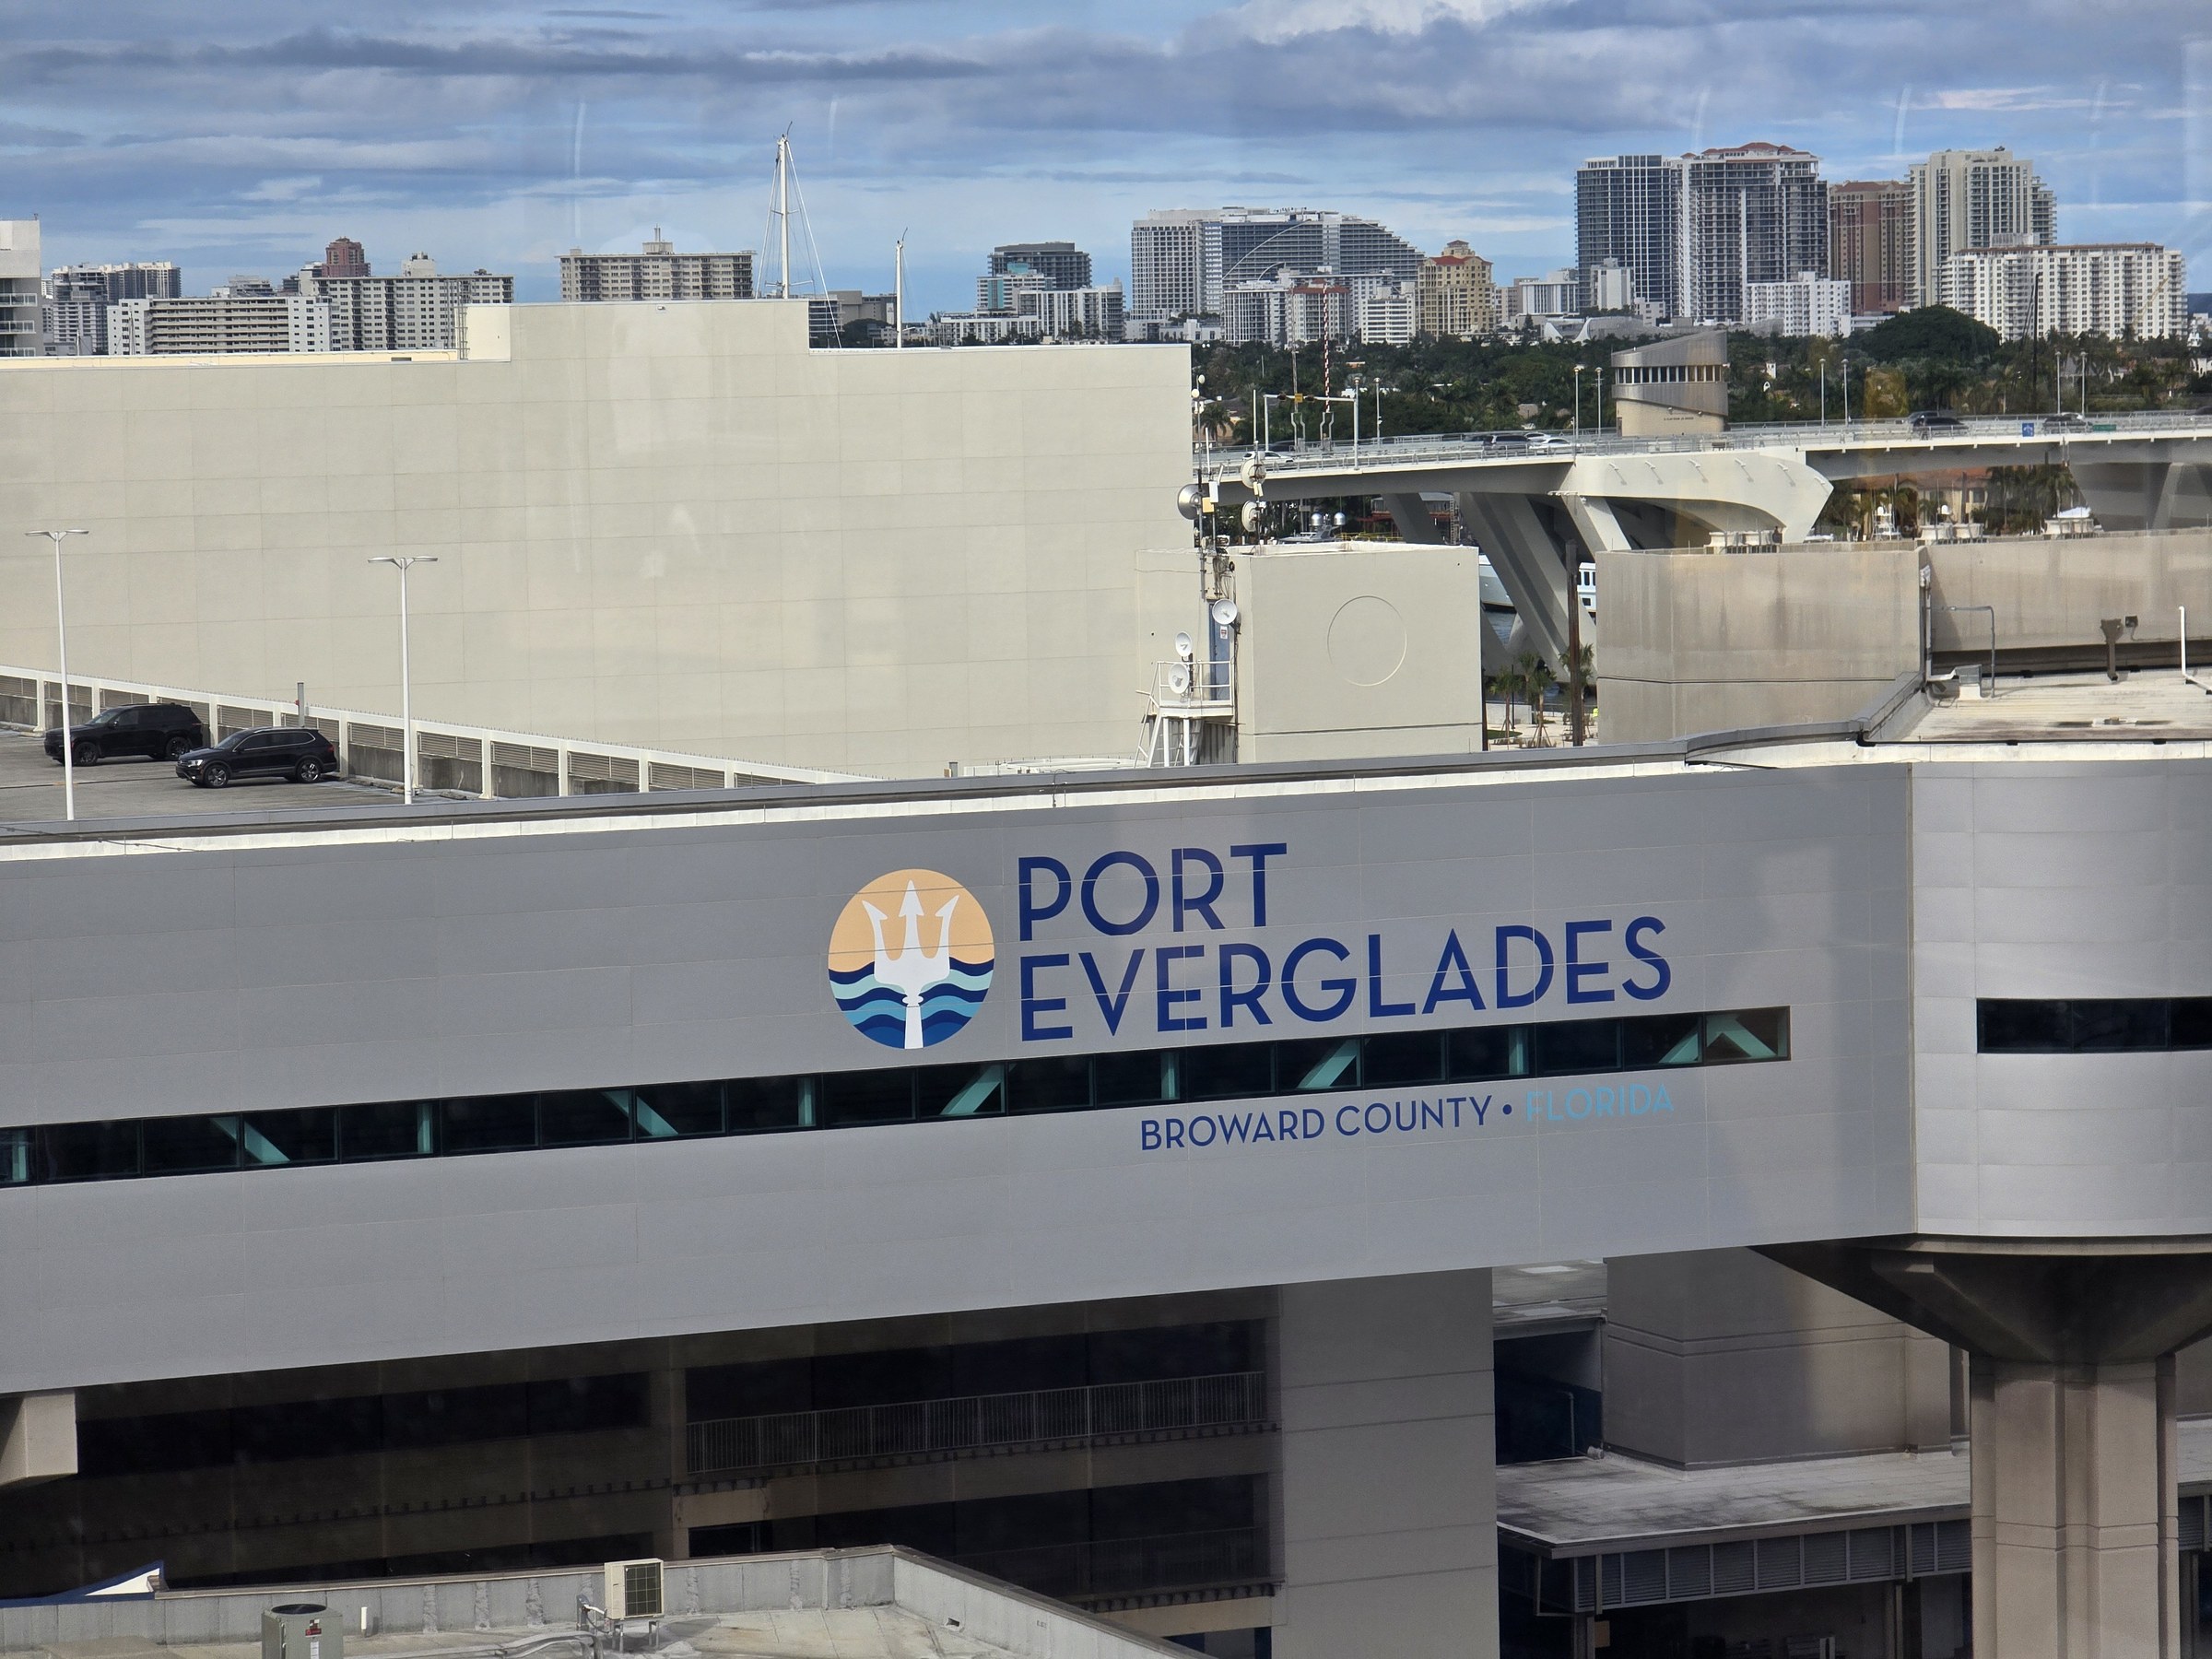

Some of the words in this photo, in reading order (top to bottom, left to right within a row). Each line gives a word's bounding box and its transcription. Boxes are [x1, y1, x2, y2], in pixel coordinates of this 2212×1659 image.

[1018, 843, 1287, 941] PORT
[1020, 916, 1671, 1041] EVERGLADES
[1140, 1108, 1325, 1151] BROWARD
[1335, 1094, 1493, 1138] COUNTY
[1525, 1082, 1675, 1124] FLORIDA
